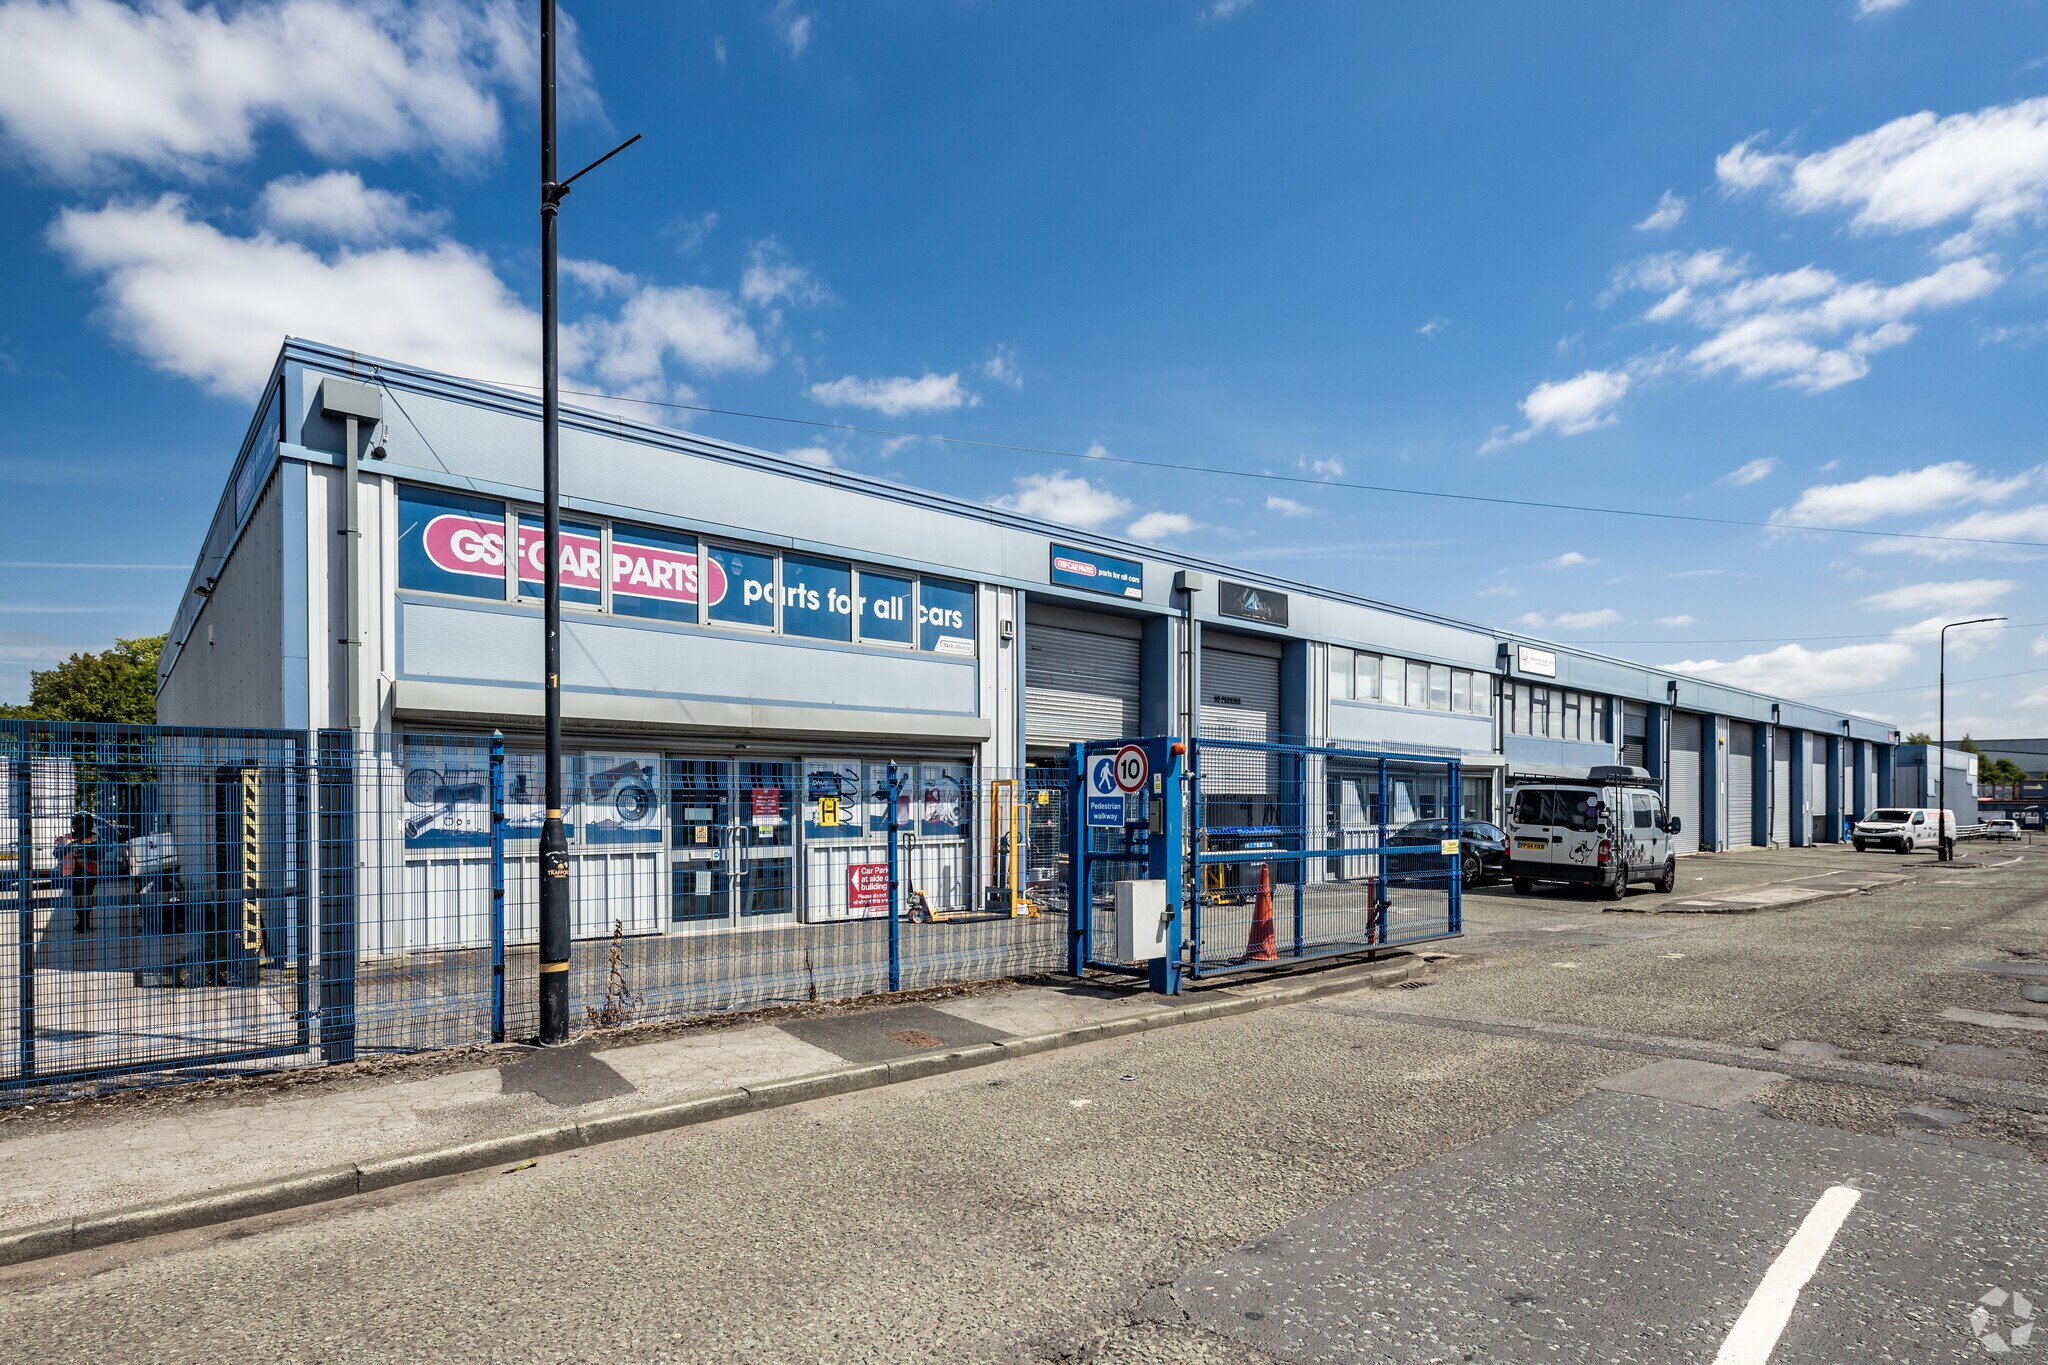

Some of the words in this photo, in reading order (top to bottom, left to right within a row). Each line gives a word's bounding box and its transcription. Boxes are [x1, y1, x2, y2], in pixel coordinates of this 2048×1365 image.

[612, 553, 698, 594] PARTS
[1057, 560, 1068, 568] GSF
[1067, 563, 1079, 571] CAR
[1078, 565, 1094, 574] PARTS
[1098, 569, 1112, 578] parts
[1112, 571, 1120, 580] for
[1120, 573, 1128, 581] all
[827, 588, 867, 615] for
[874, 596, 903, 621] all
[550, 674, 558, 688] 1
[1121, 758, 1140, 779] 10
[861, 883, 887, 891] building
